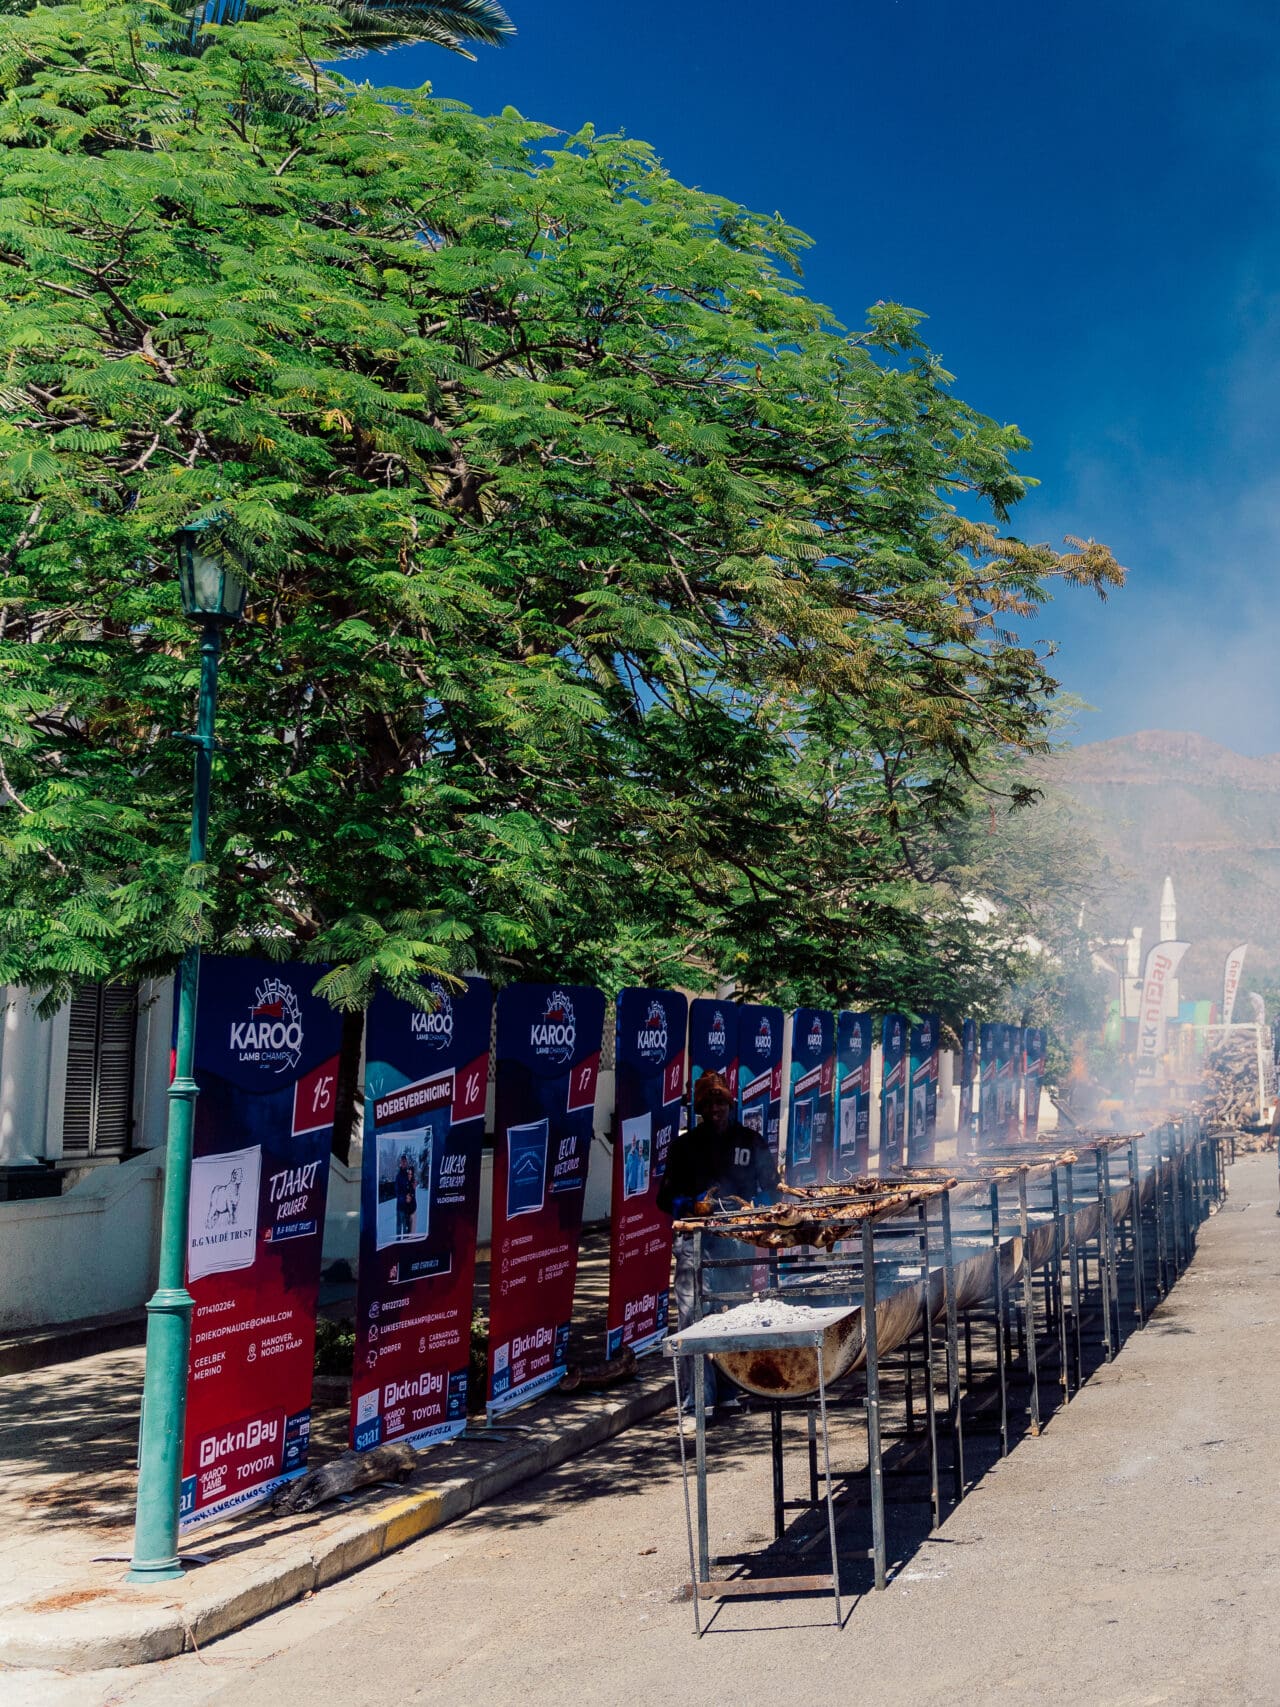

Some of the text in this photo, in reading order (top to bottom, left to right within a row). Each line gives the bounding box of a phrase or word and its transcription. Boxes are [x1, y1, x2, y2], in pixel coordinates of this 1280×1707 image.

[411, 1013, 453, 1033] KAROO
[230, 1022, 301, 1050] KAROO
[530, 1024, 576, 1046] KAROO
[637, 1030, 668, 1049] KAROO
[708, 1031, 726, 1045] KAROO
[755, 1035, 772, 1048] KAROO
[239, 1052, 260, 1062] LAMB
[579, 1067, 592, 1091] 17
[670, 1064, 680, 1091] 18
[312, 1076, 334, 1113] 15
[465, 1072, 480, 1105] 16
[376, 1082, 451, 1120] BOEREVERENIGING
[439, 1153, 467, 1175] LUKAS
[734, 1147, 751, 1166] 10
[269, 1159, 323, 1203] TJAART
[276, 1195, 309, 1221] KRUGER
[230, 1228, 253, 1241] TRUST
[195, 1310, 293, 1344] DRIEKOPNAUDE@GMAIL.COM
[260, 1338, 303, 1358] NOORD KAAP
[379, 1342, 402, 1356] DORPER
[194, 1351, 226, 1369] GEELBEK
[530, 1354, 550, 1370] TOYOTA
[193, 1364, 222, 1381] MERINO
[420, 1372, 443, 1396] Pay
[412, 1403, 441, 1421] TOYOTA
[386, 1416, 402, 1429] LAMB
[246, 1419, 278, 1449] Pay
[356, 1424, 380, 1451] saai
[202, 1464, 229, 1484] KAROO
[236, 1454, 275, 1481] TOYOTA
[202, 1476, 222, 1494] LAMB
